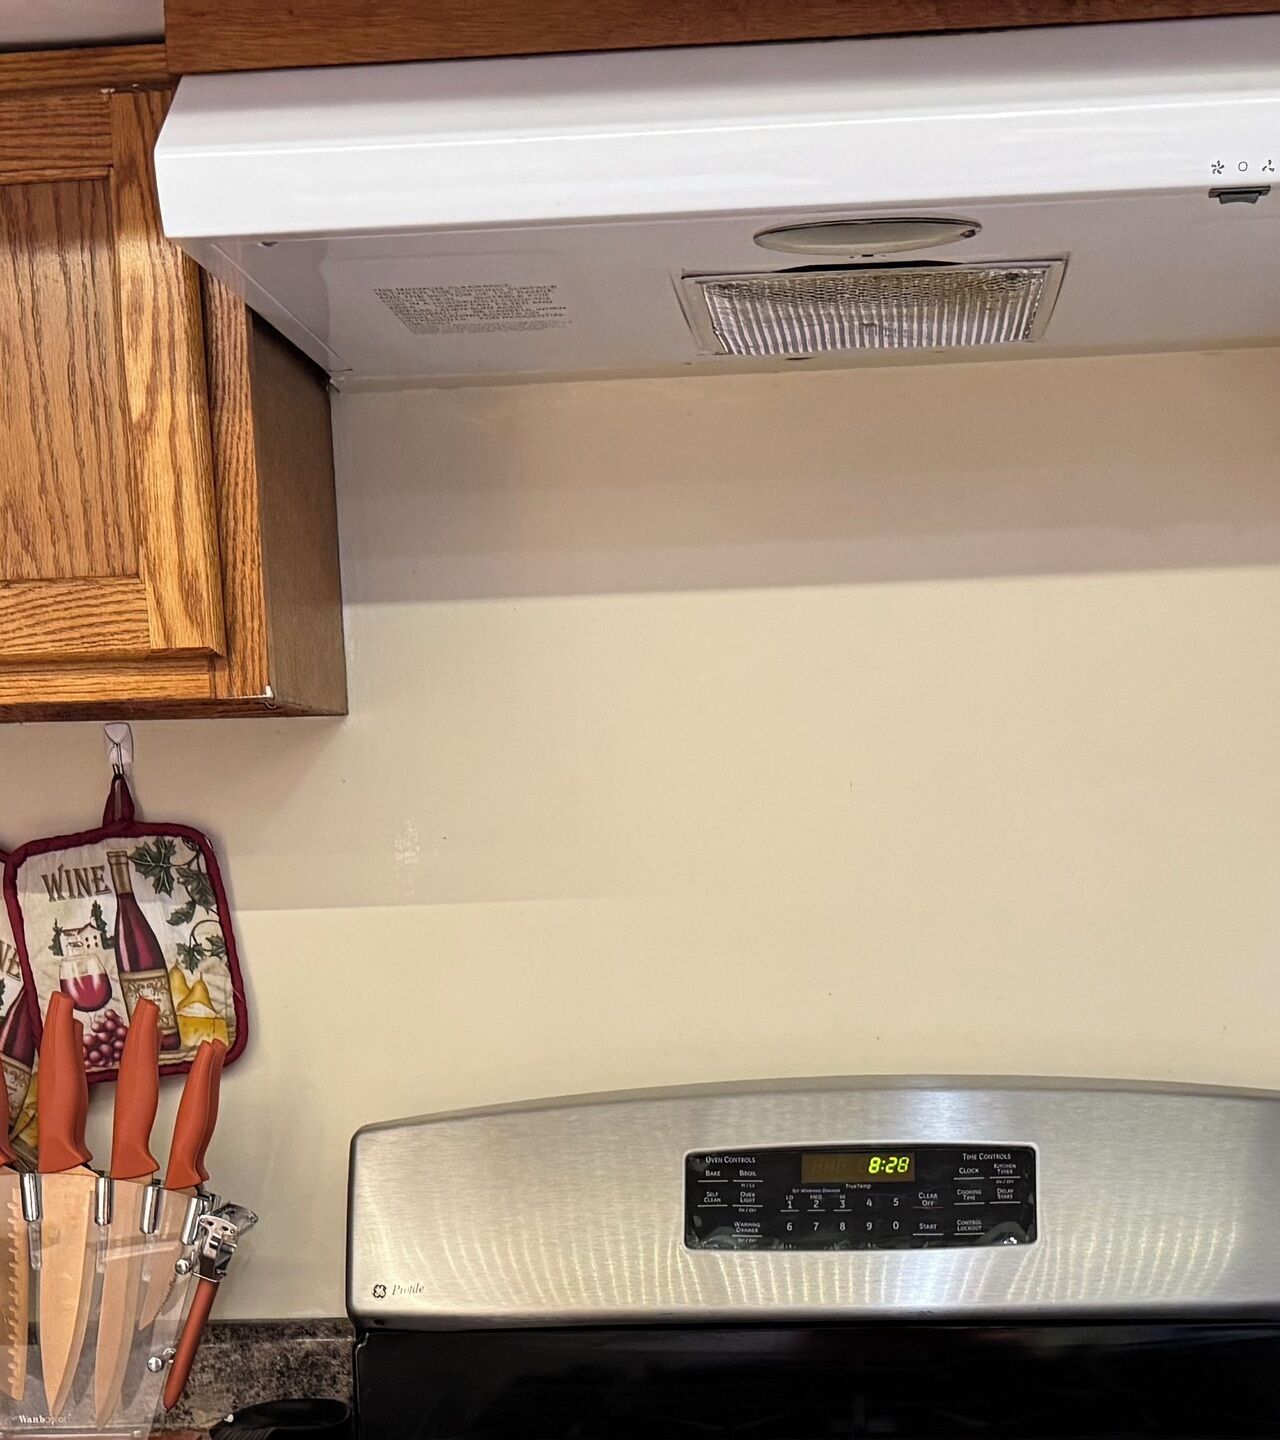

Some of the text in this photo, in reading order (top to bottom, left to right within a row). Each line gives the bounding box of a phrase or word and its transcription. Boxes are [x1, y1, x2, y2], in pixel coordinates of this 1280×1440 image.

[42, 864, 112, 902] WINE
[868, 1157, 909, 1173] 8:28
[893, 1198, 899, 1206] 5
[787, 1223, 792, 1231] 6
[813, 1223, 819, 1231] 7
[840, 1222, 845, 1231] 8
[867, 1222, 872, 1230] 9
[893, 1222, 899, 1230] 0
